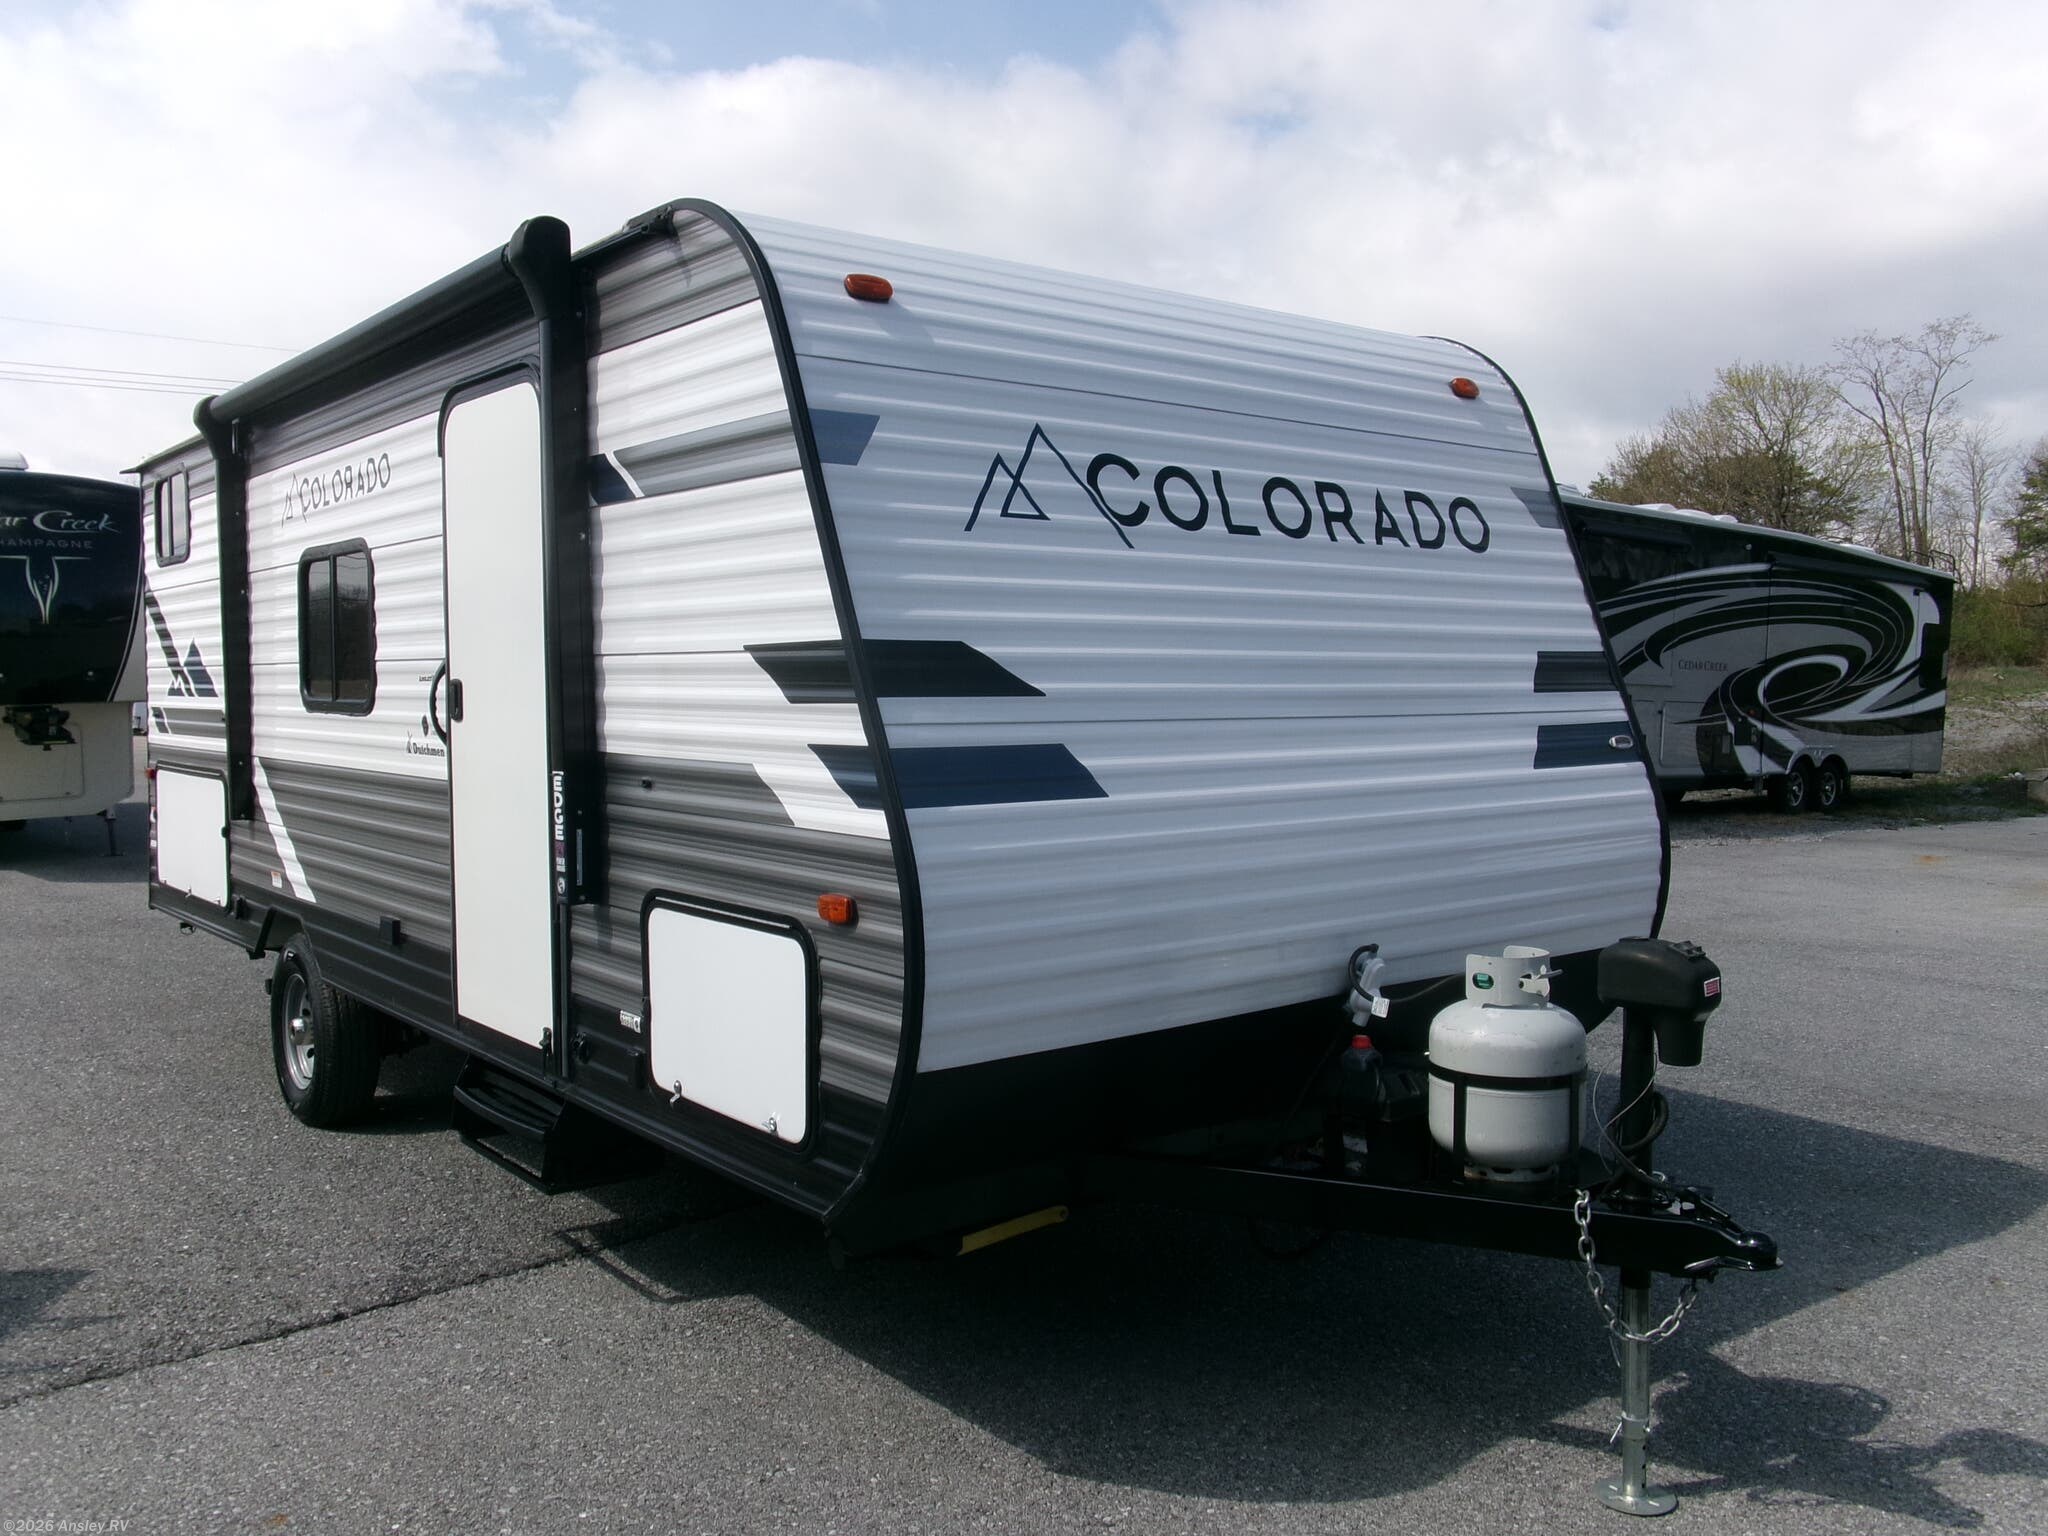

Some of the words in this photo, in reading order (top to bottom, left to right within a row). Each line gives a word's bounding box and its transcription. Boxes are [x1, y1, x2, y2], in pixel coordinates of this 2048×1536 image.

[300, 453, 391, 512] COLORADO
[1086, 452, 1490, 553] COLORADO
[33, 510, 121, 533] Creek
